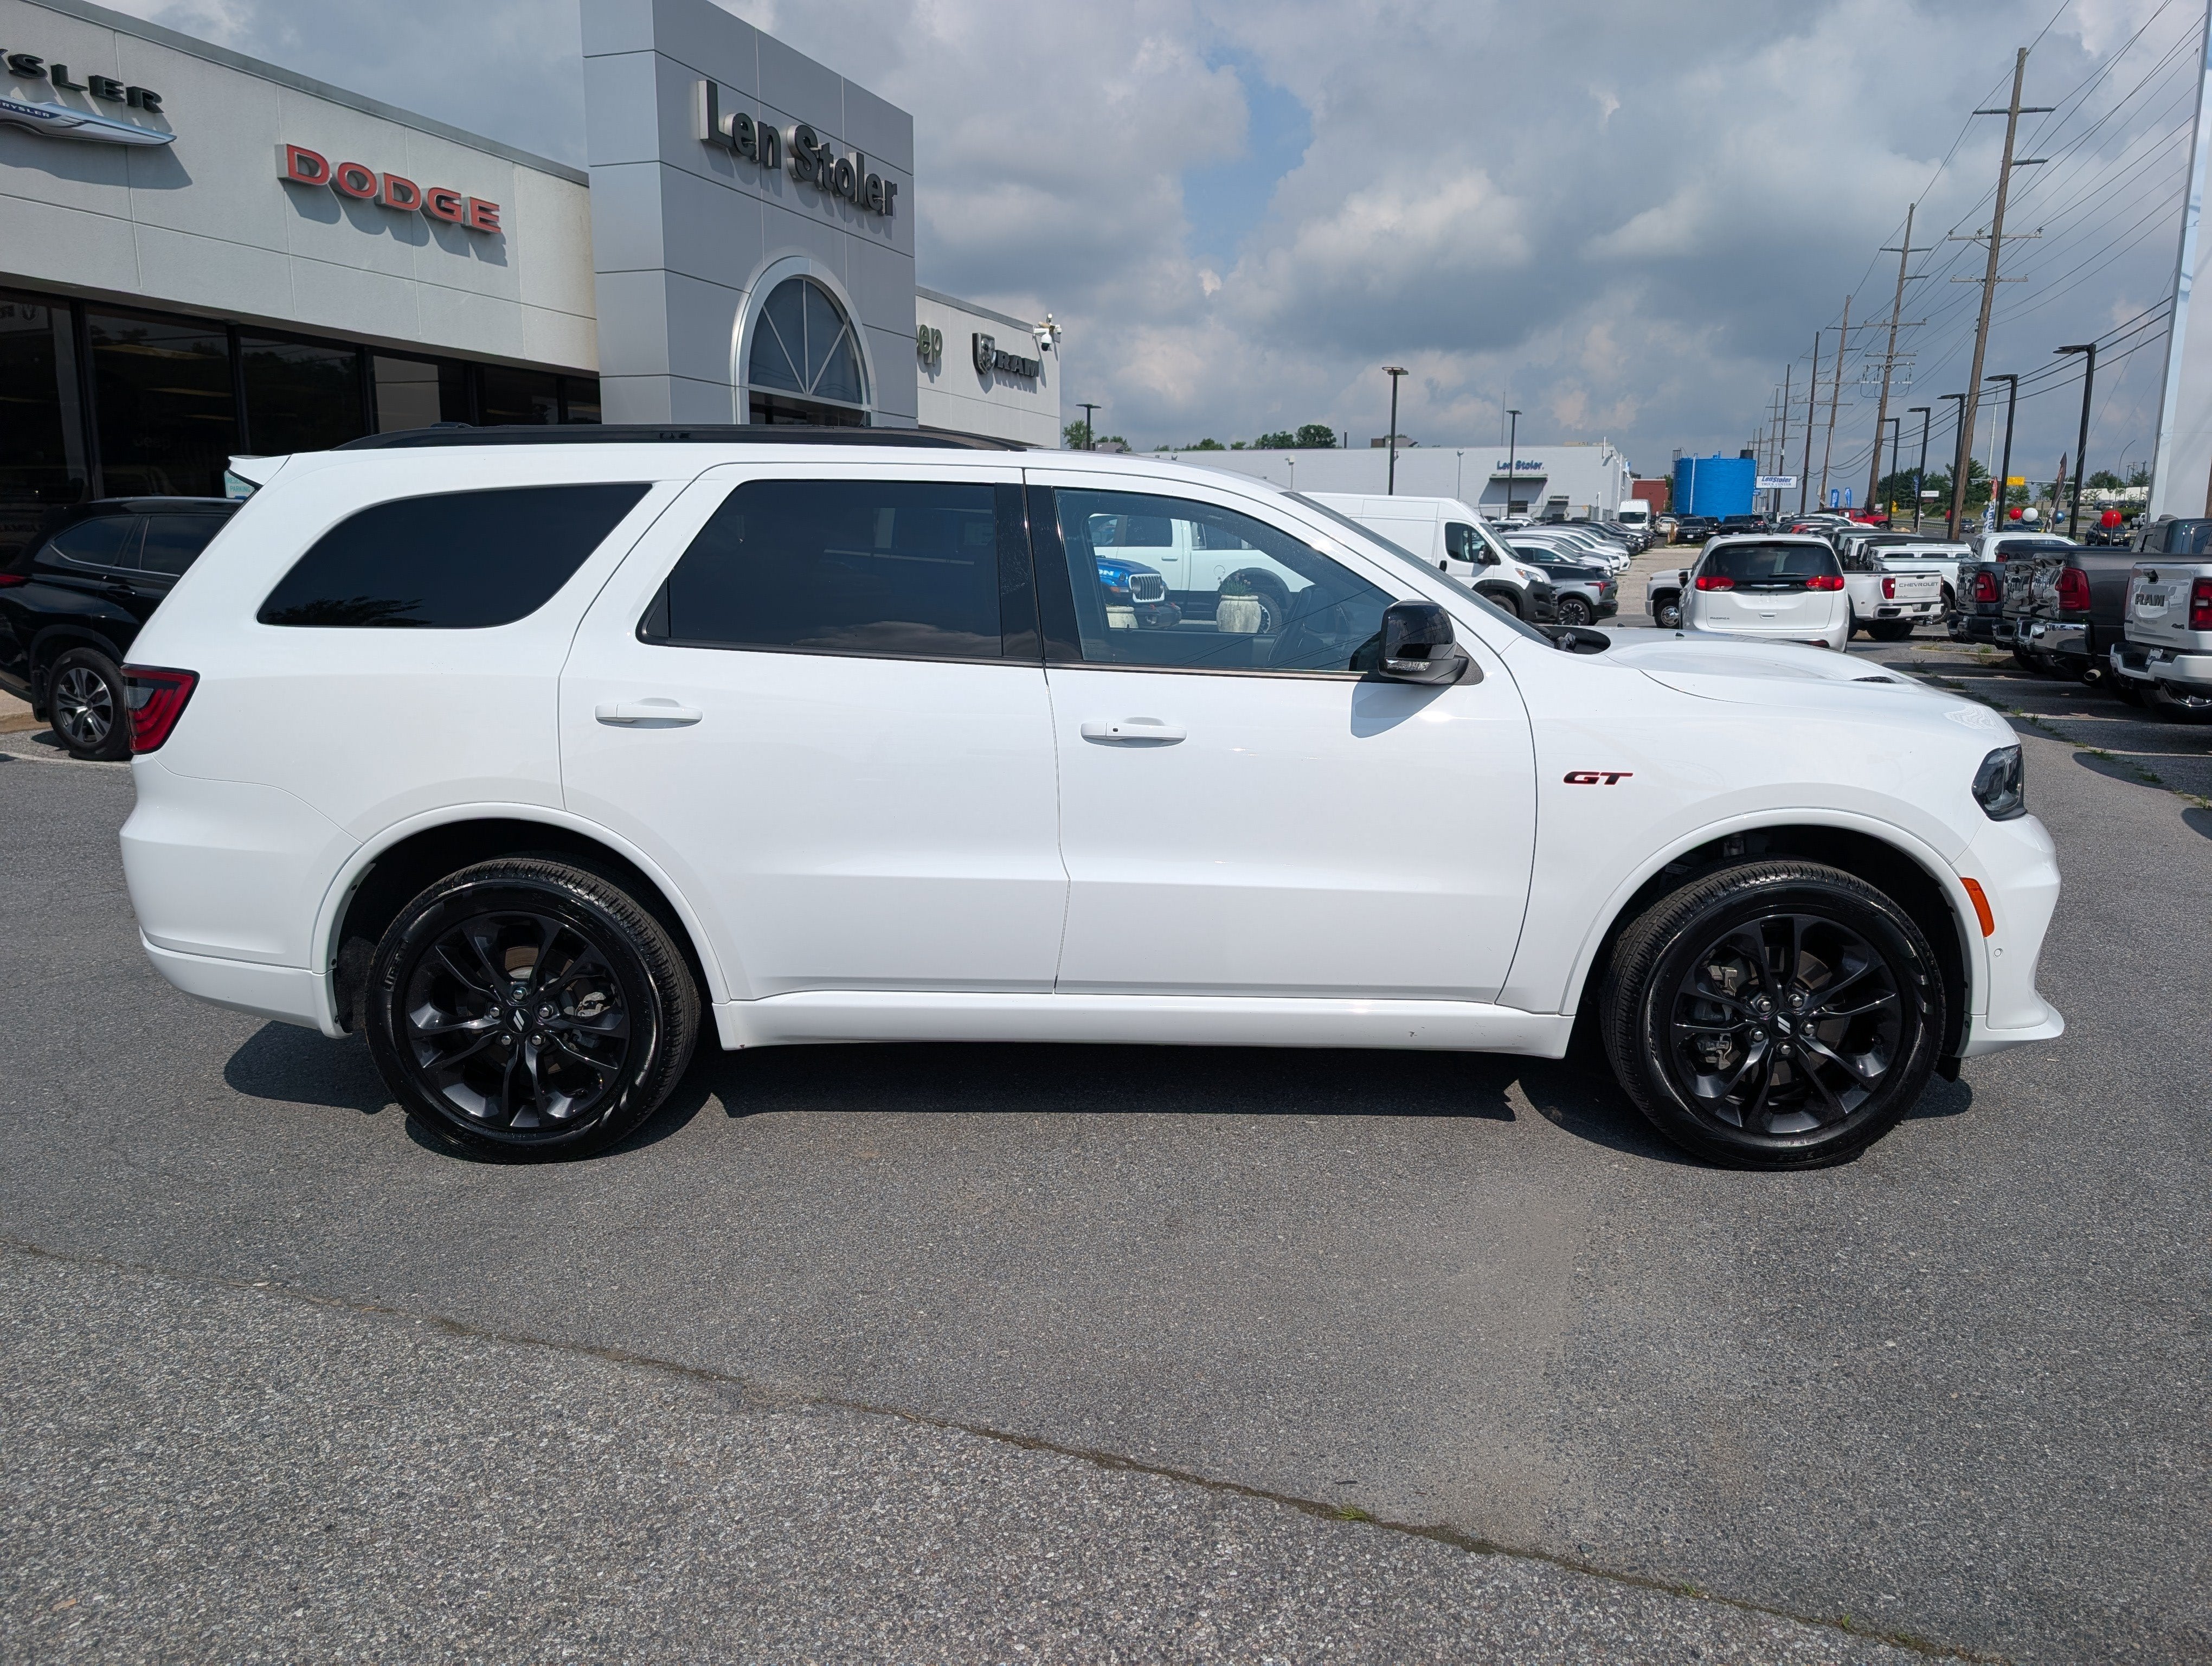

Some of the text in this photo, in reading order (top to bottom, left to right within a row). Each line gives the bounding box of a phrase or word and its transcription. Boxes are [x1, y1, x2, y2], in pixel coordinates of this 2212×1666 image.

[0, 49, 164, 113] SLER
[698, 80, 897, 216] Len Stoler
[275, 144, 501, 234] DODGE
[995, 350, 1039, 377] RAM
[2135, 593, 2165, 606] RAM
[1563, 771, 1634, 785] GT
